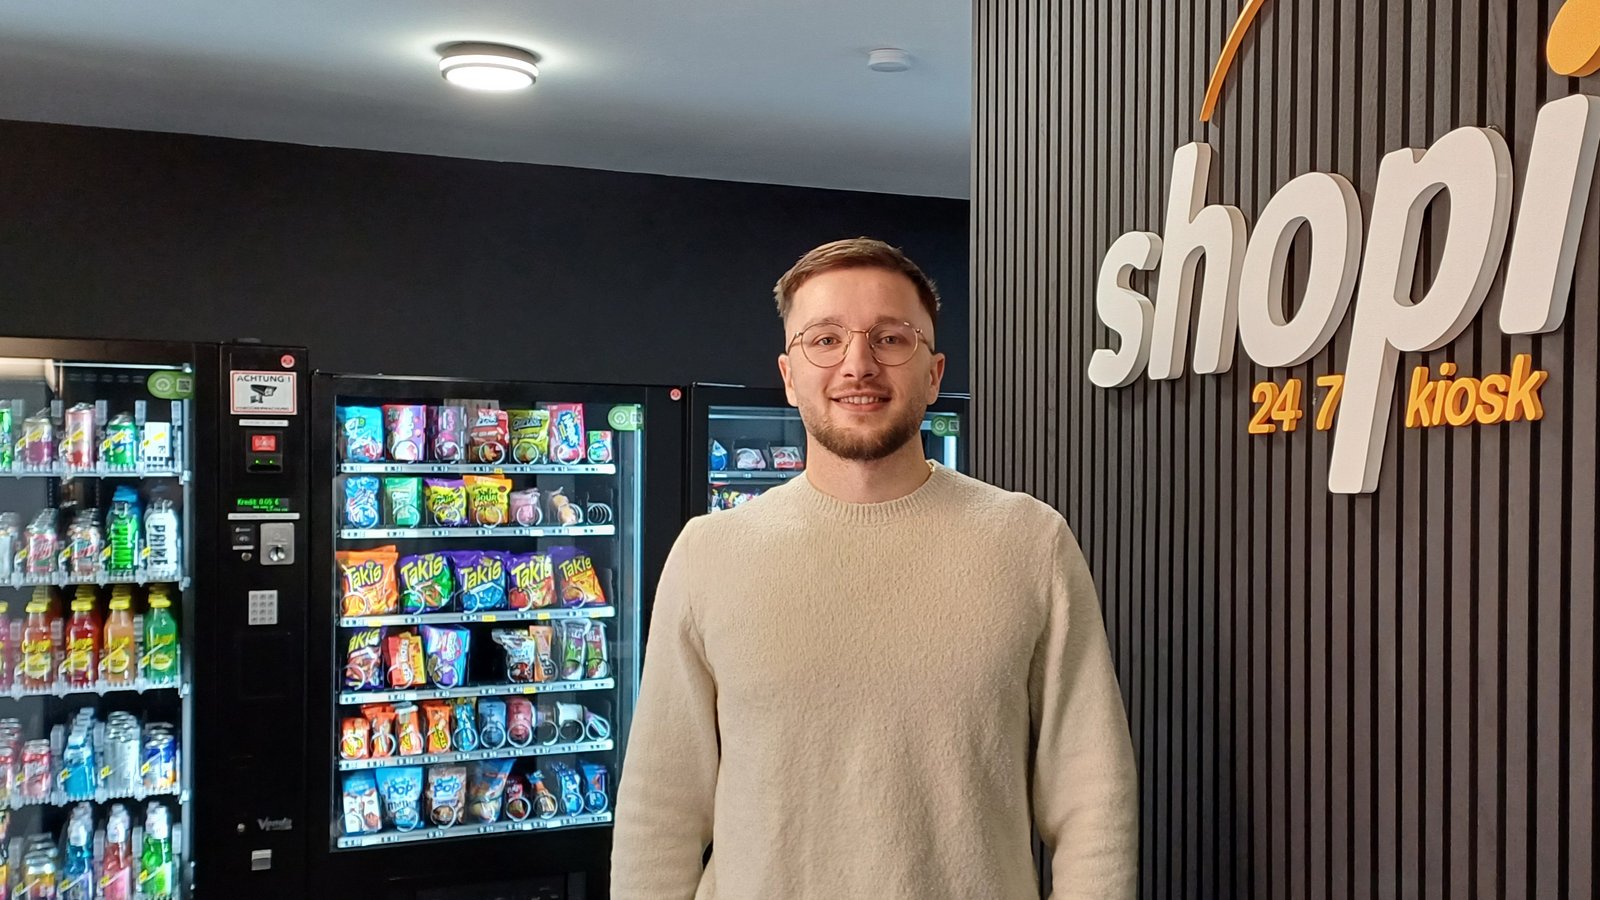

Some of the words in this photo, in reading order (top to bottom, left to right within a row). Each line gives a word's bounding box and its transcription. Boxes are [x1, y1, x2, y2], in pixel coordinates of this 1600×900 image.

[237, 375, 284, 383] ACHTUNG
[1248, 378, 1302, 434] 24
[1316, 374, 1344, 431] 7
[1405, 353, 1548, 428] kiosk
[237, 498, 257, 506] Kredit
[150, 524, 168, 566] PRIME
